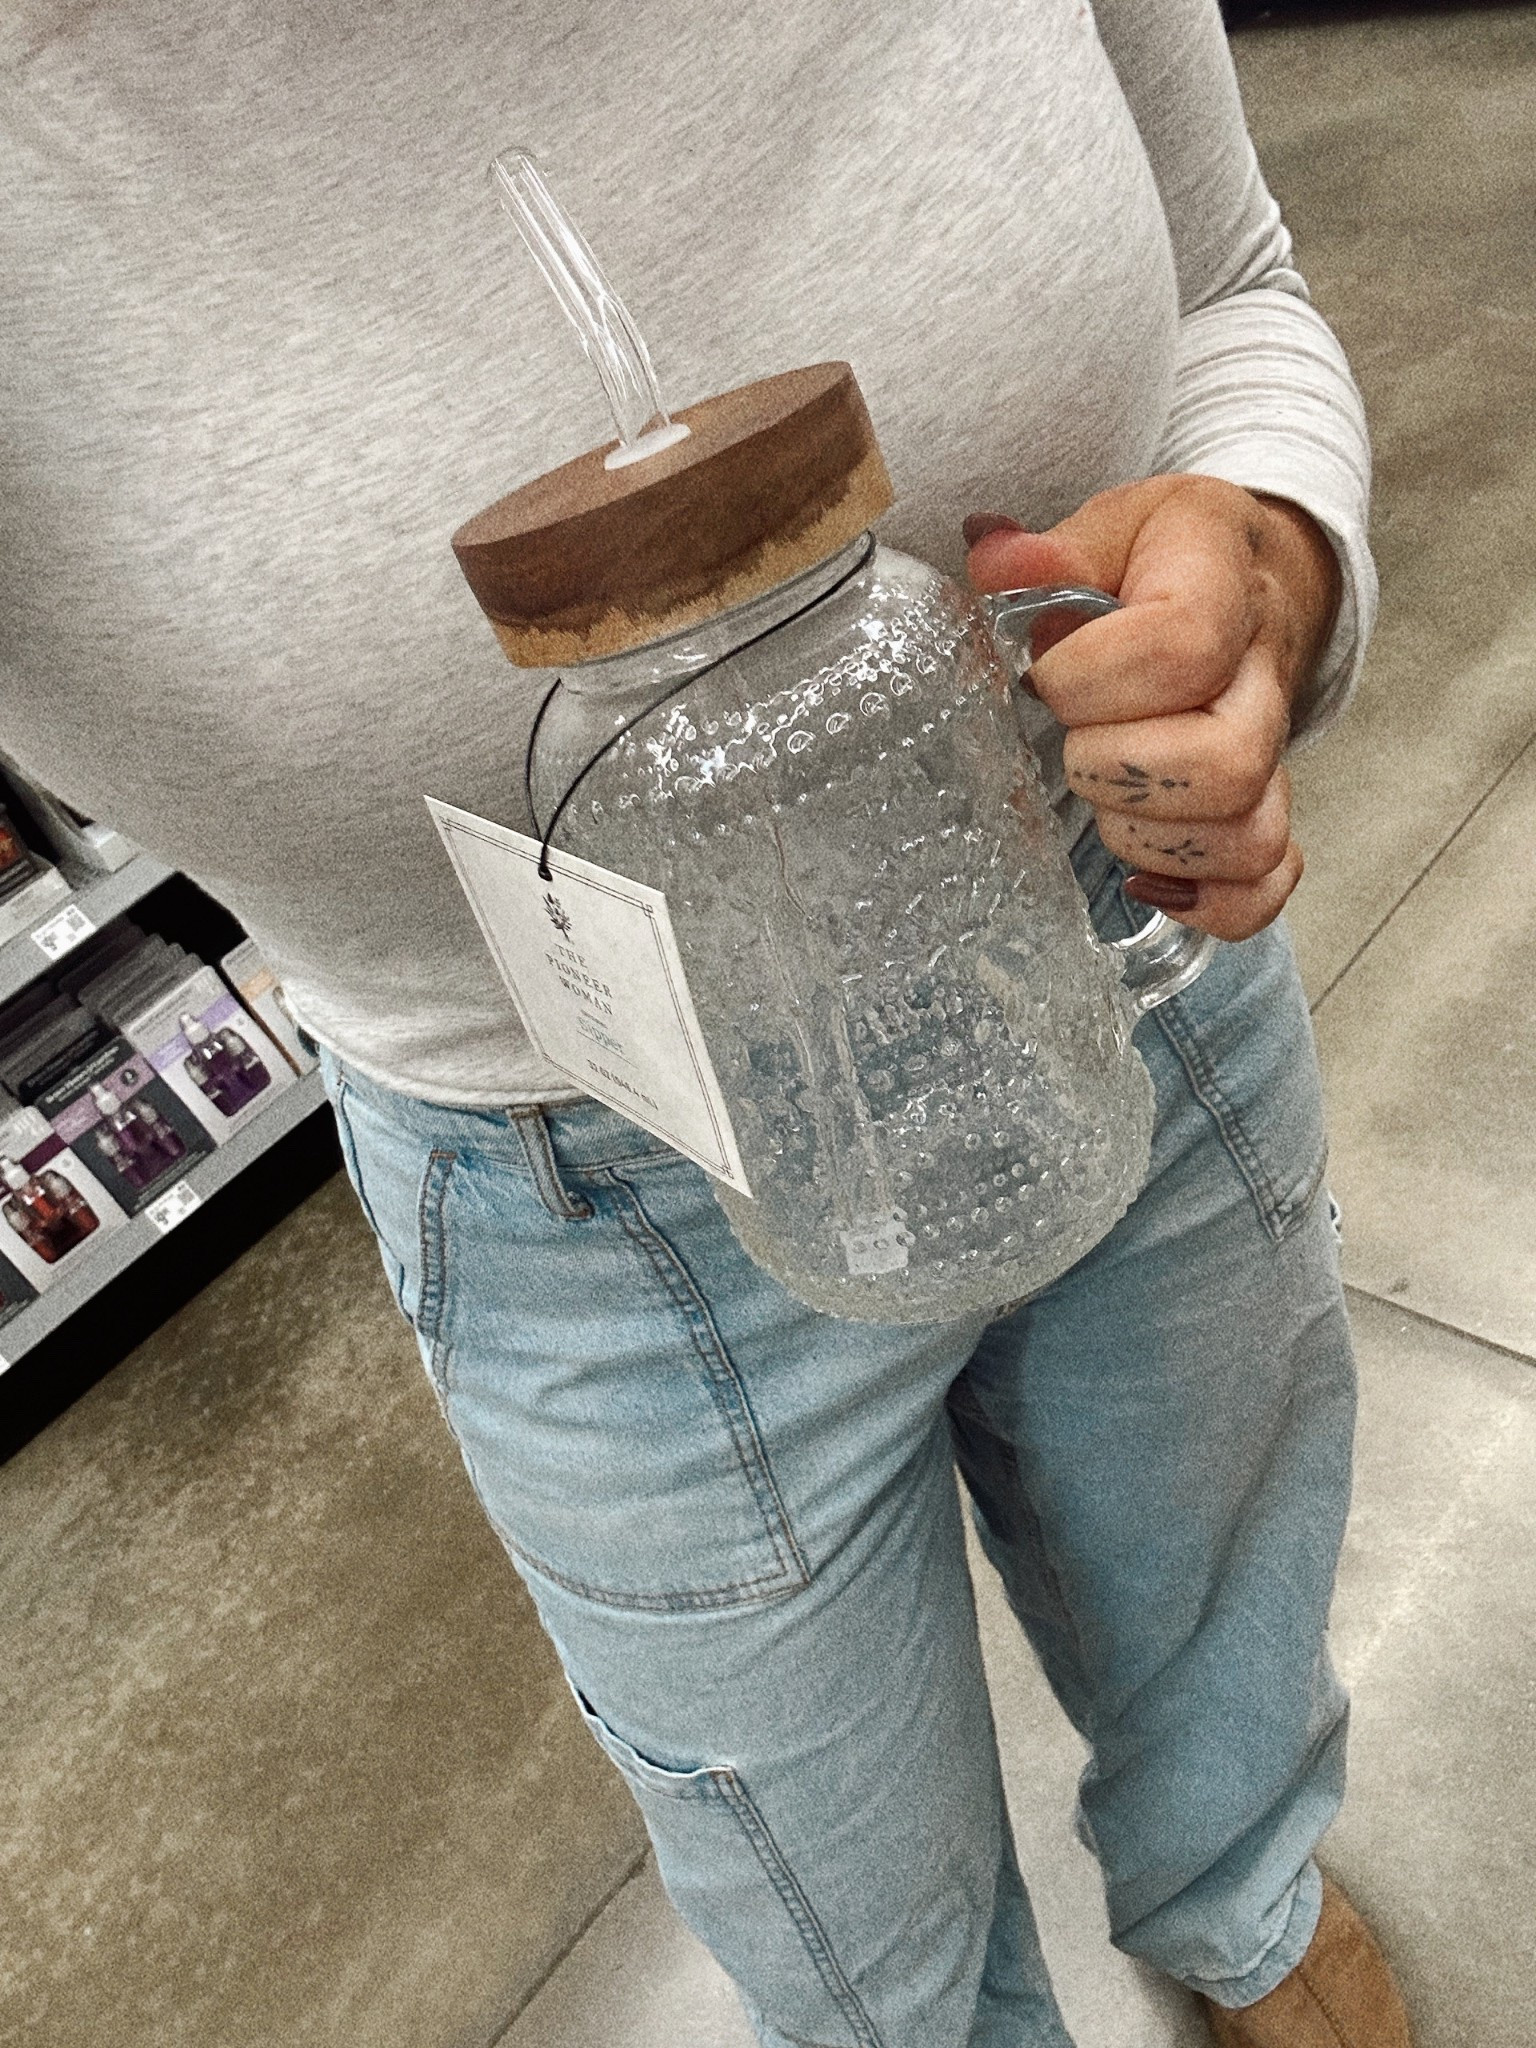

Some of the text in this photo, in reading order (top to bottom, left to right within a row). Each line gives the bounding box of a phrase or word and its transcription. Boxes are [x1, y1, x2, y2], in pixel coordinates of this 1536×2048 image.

[554, 942, 588, 968] THE
[545, 952, 612, 999] PIONEER
[558, 974, 612, 1015] WOMAN
[577, 1015, 626, 1055] Sipper
